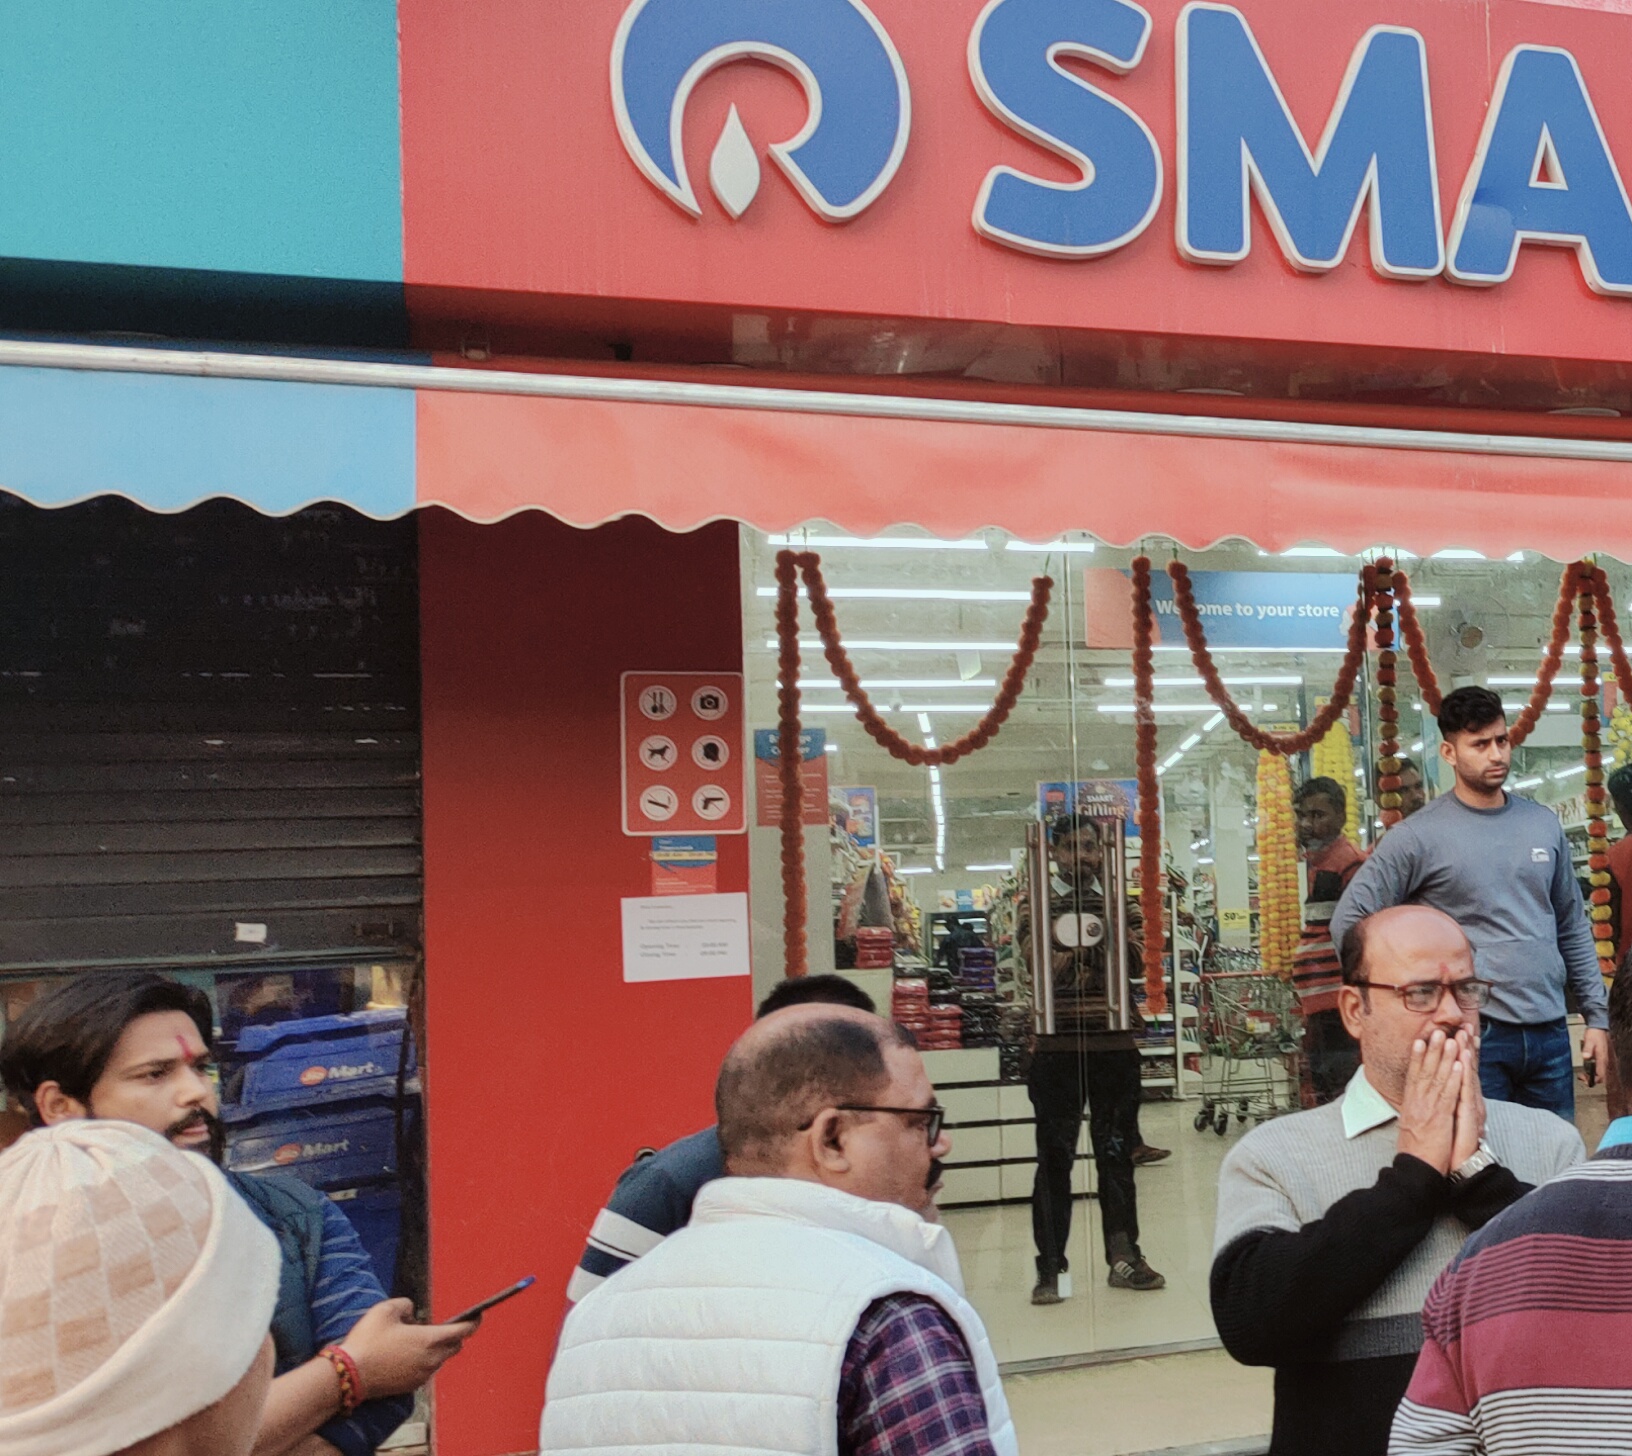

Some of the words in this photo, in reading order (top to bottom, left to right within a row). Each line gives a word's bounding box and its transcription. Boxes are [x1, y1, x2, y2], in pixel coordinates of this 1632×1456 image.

[1155, 599, 1233, 616] Weome
[1234, 602, 1254, 616] to
[1256, 605, 1295, 620] your
[1298, 604, 1340, 617] store
